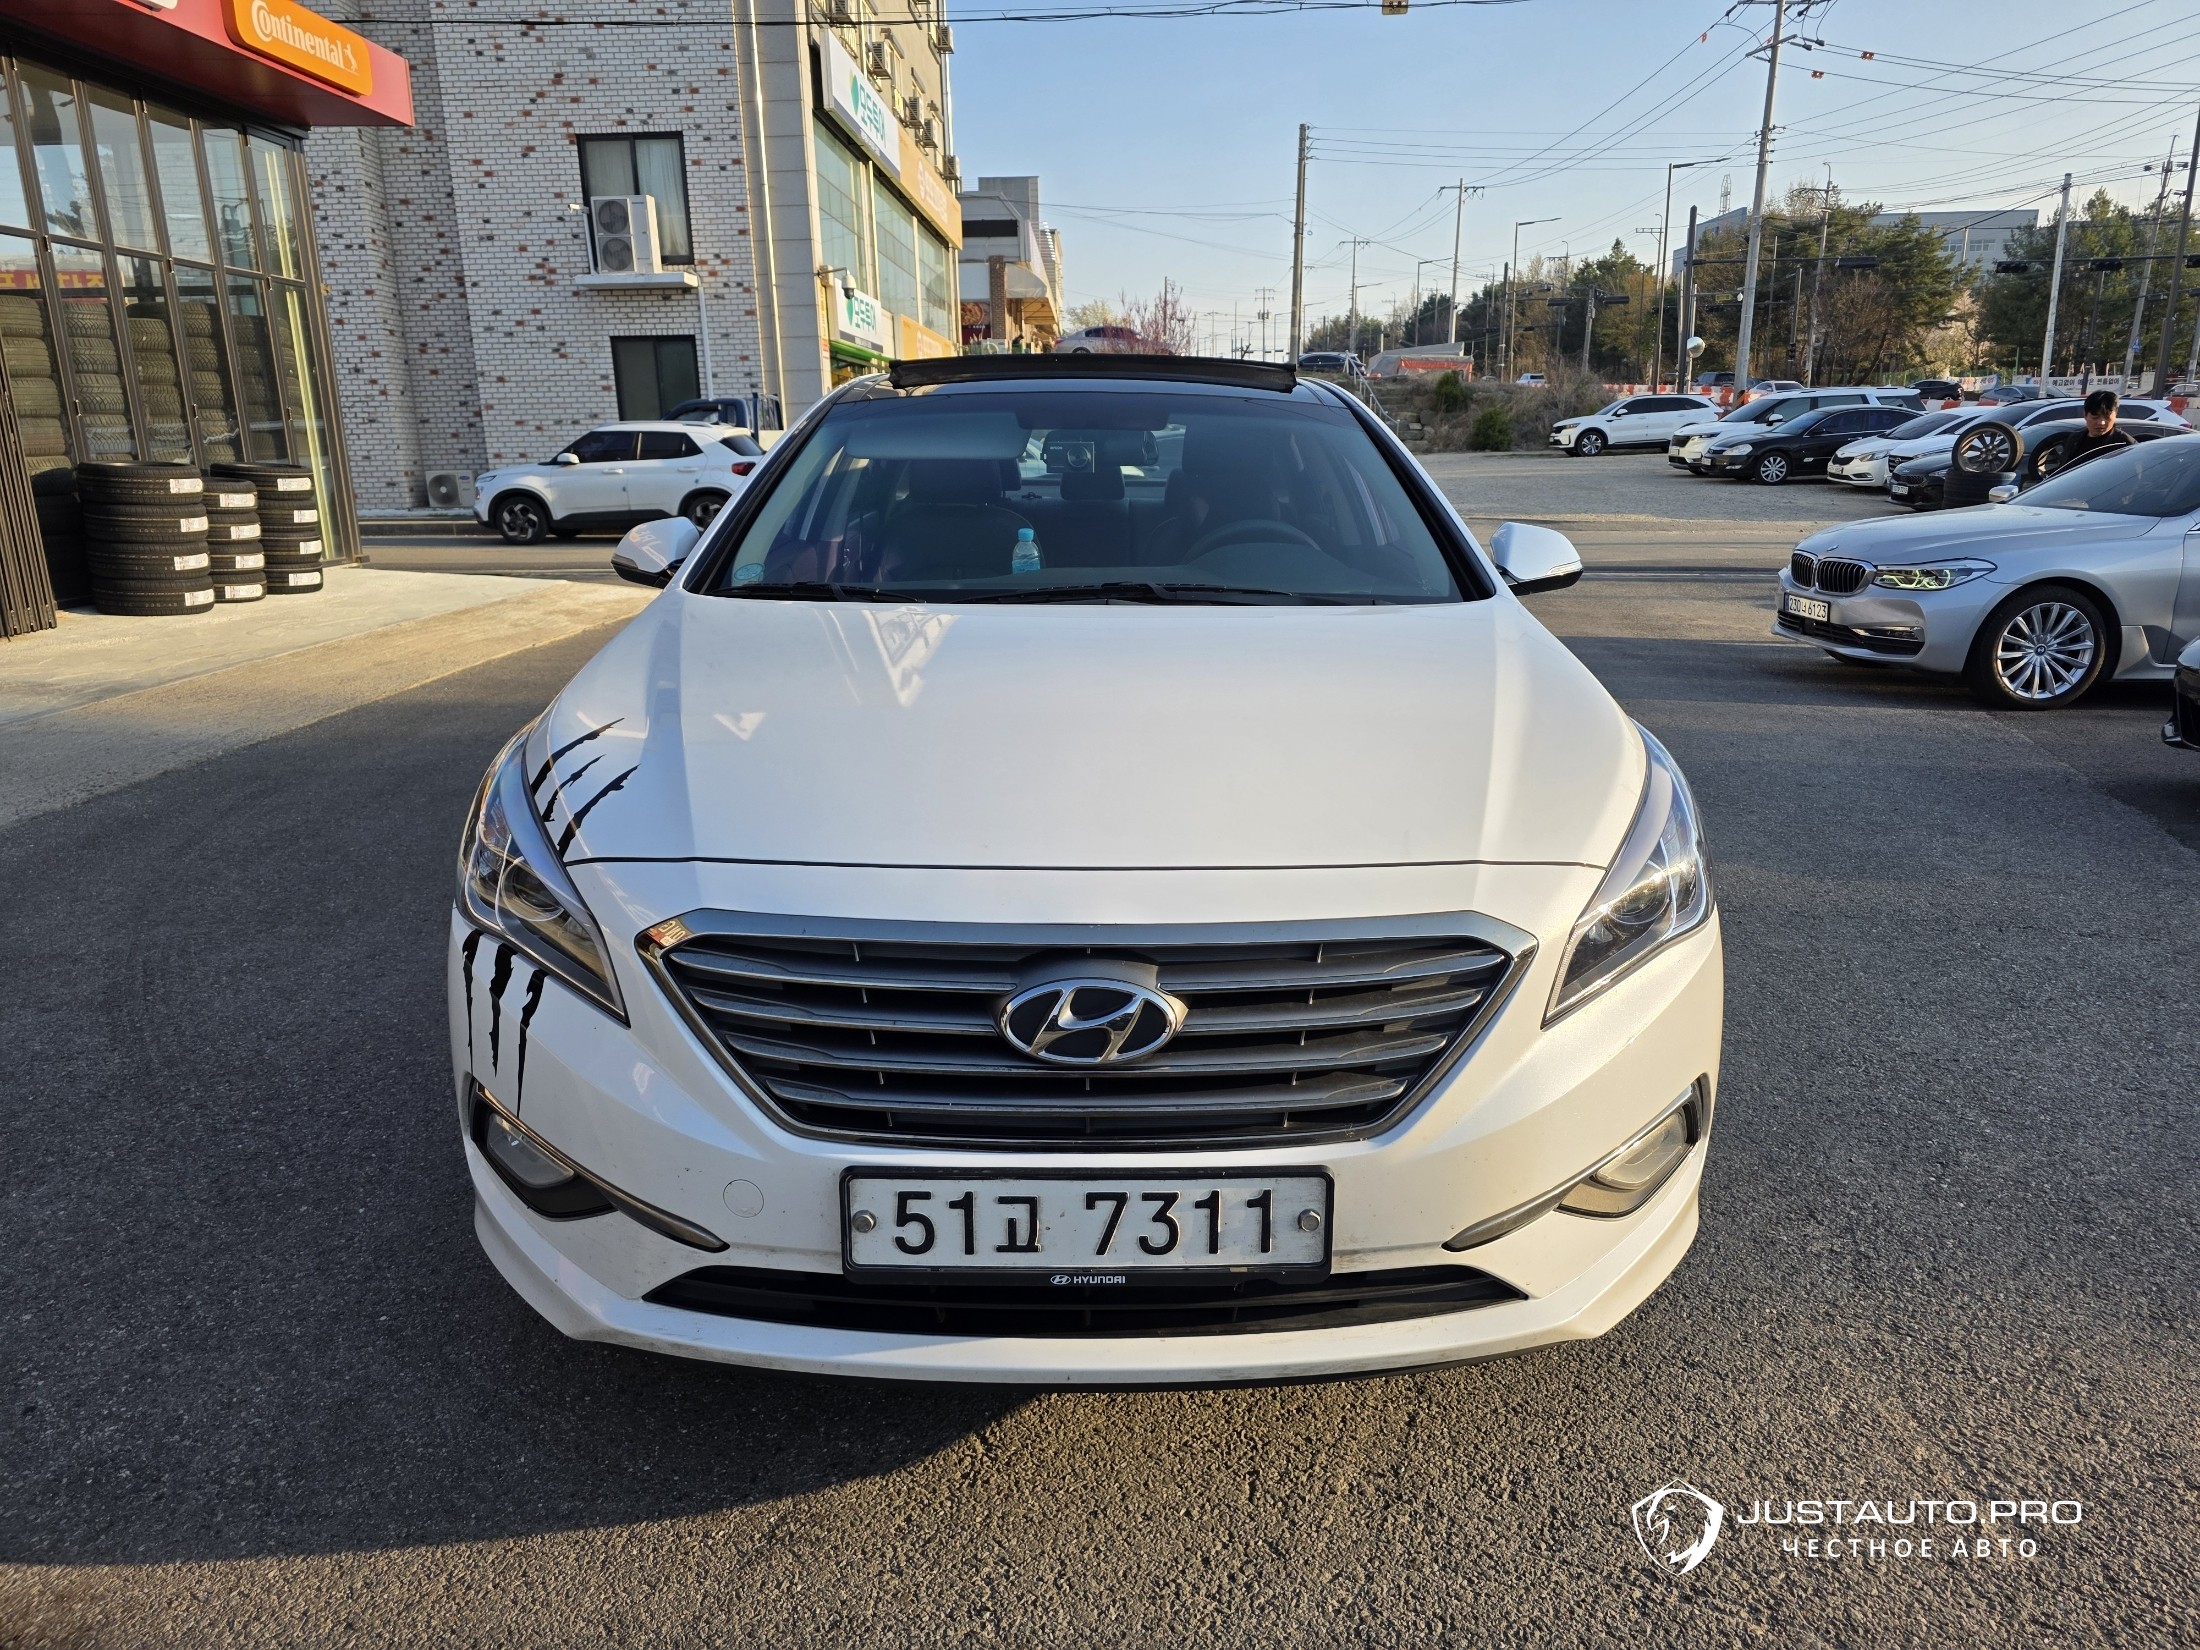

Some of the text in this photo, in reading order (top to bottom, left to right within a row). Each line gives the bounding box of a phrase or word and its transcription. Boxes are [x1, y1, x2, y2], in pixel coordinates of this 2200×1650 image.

[251, 0, 345, 70] Continental
[859, 83, 887, 149] 모두투어
[853, 296, 877, 334] 모두투어
[893, 1188, 1275, 1256] 51고 7311
[1072, 1274, 1127, 1286] HYUNDAI
